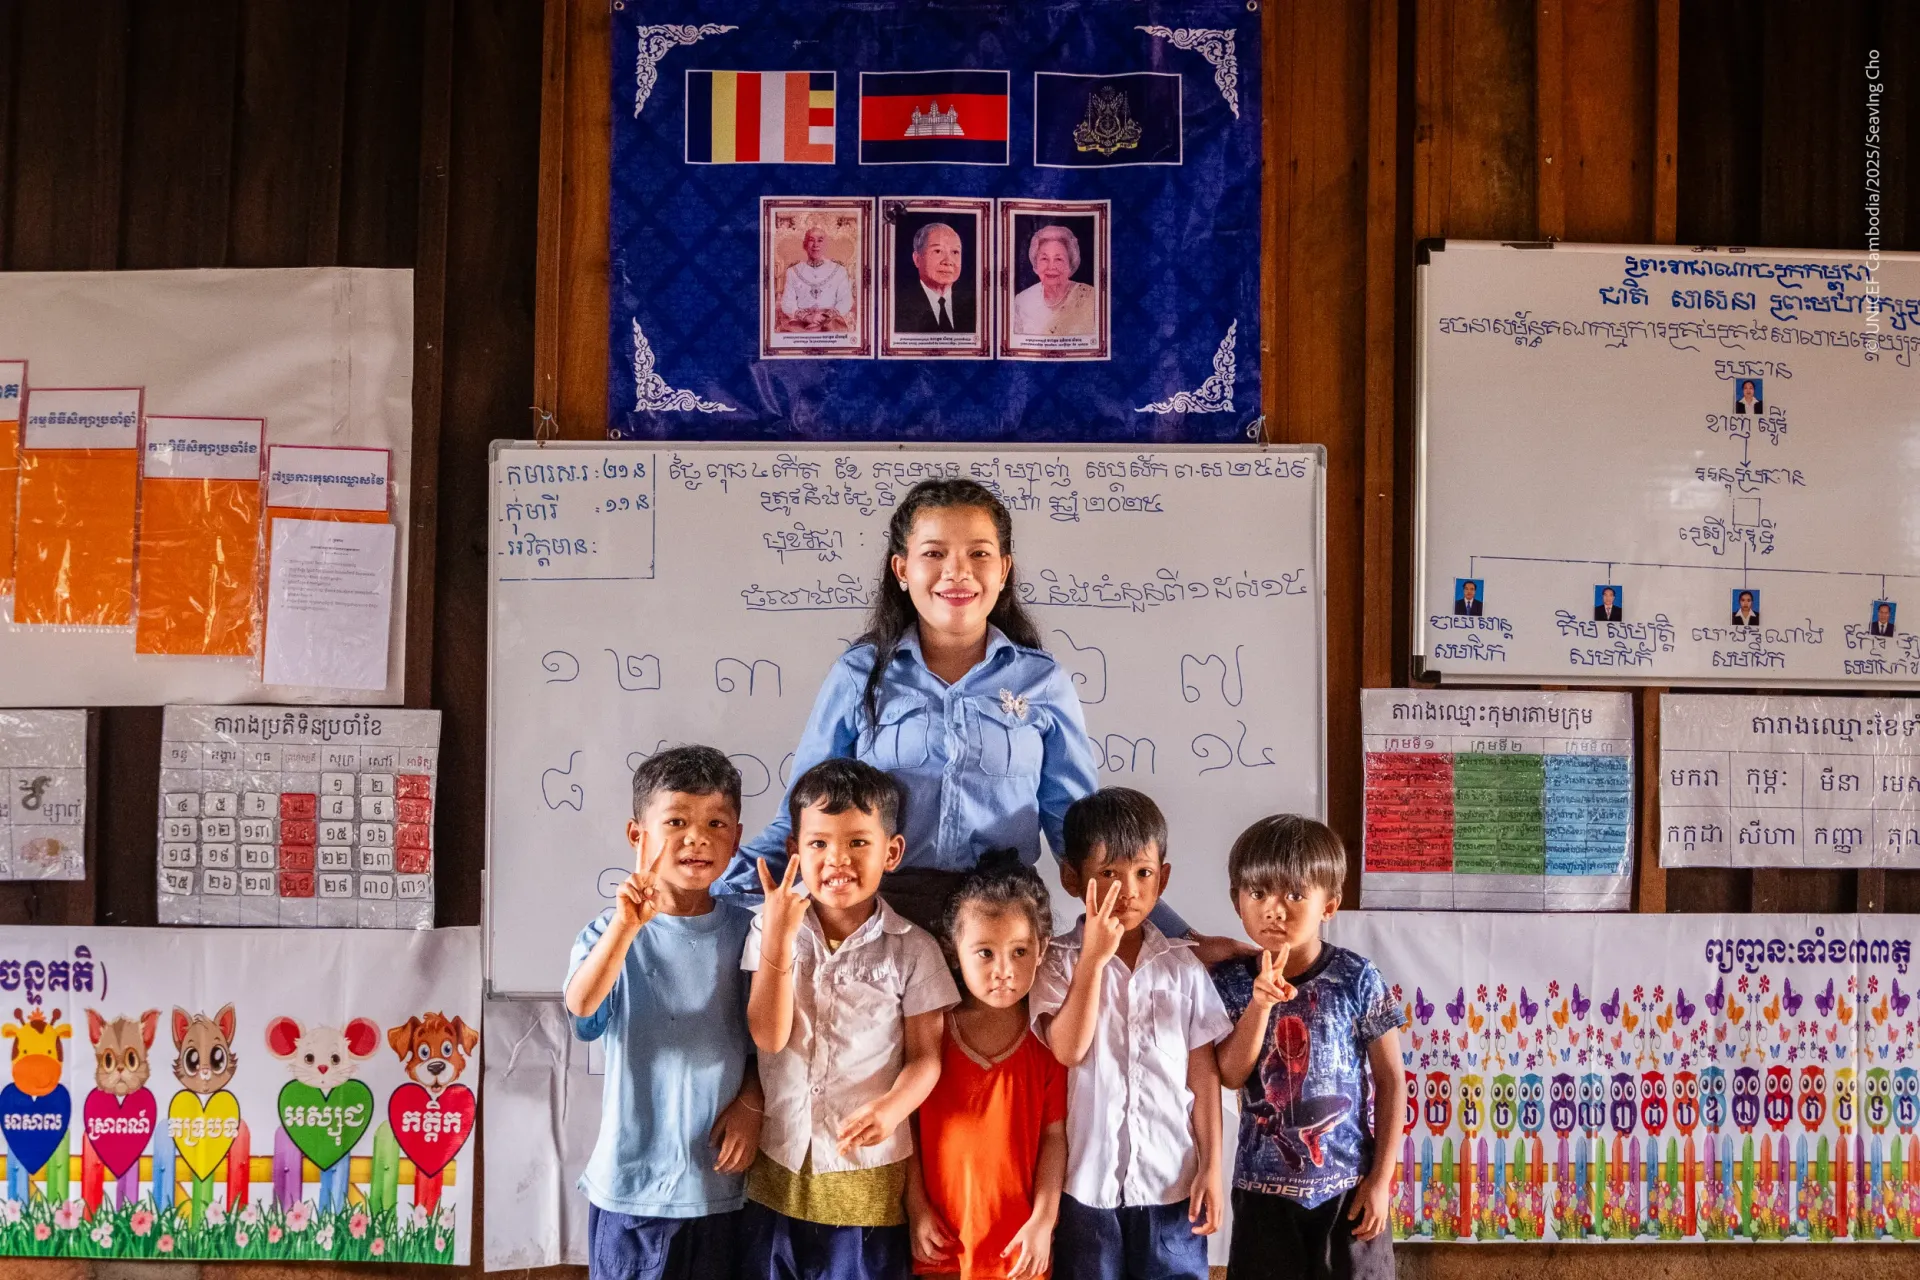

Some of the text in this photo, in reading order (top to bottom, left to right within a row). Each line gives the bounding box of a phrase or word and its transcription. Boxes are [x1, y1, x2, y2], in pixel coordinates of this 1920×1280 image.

[1600, 278, 1649, 306] ជាតិ
[1671, 289, 1756, 311] សាសនា
[1714, 359, 1793, 381] ប្រធាន
[1435, 633, 1506, 662] សមាជិក
[1569, 641, 1653, 667] សមាជិក
[1712, 641, 1785, 669] សមាជិក
[541, 650, 579, 683] ១
[604, 649, 661, 691] ២
[715, 657, 782, 697] ៣
[1181, 644, 1244, 707] ៧
[214, 713, 382, 741] តារាងប្រតិទិនប្រចាំខែ
[1392, 701, 1593, 730] តារាងឈ្មោះកុមារតាមក្រុម
[333, 778, 343, 792] ១
[371, 778, 383, 793] ២
[541, 750, 583, 811] ៨
[1671, 768, 1718, 787] មករា
[1747, 768, 1787, 794] កុម្ភៈ
[1820, 766, 1860, 792] មីនា
[170, 823, 191, 837] ១១
[207, 823, 230, 837] ១២
[326, 827, 347, 841] ១៥
[367, 828, 386, 842] ១៦
[1667, 823, 1723, 851] កក្កដា
[1739, 819, 1795, 845] សីហា
[1814, 825, 1862, 854] កញ្ញា
[169, 847, 191, 862] ១៨
[245, 849, 269, 863] ២០
[321, 851, 347, 865] ២២
[363, 851, 390, 866] ២៣
[208, 873, 231, 890] ២៦
[245, 876, 271, 891] ២៧
[324, 878, 348, 893] ២៩
[363, 879, 389, 894] ៣០
[1705, 926, 1912, 974] ព្យញ្ជនៈទាំង៣៣តួ
[1288, 1172, 1341, 1185] AMAZING
